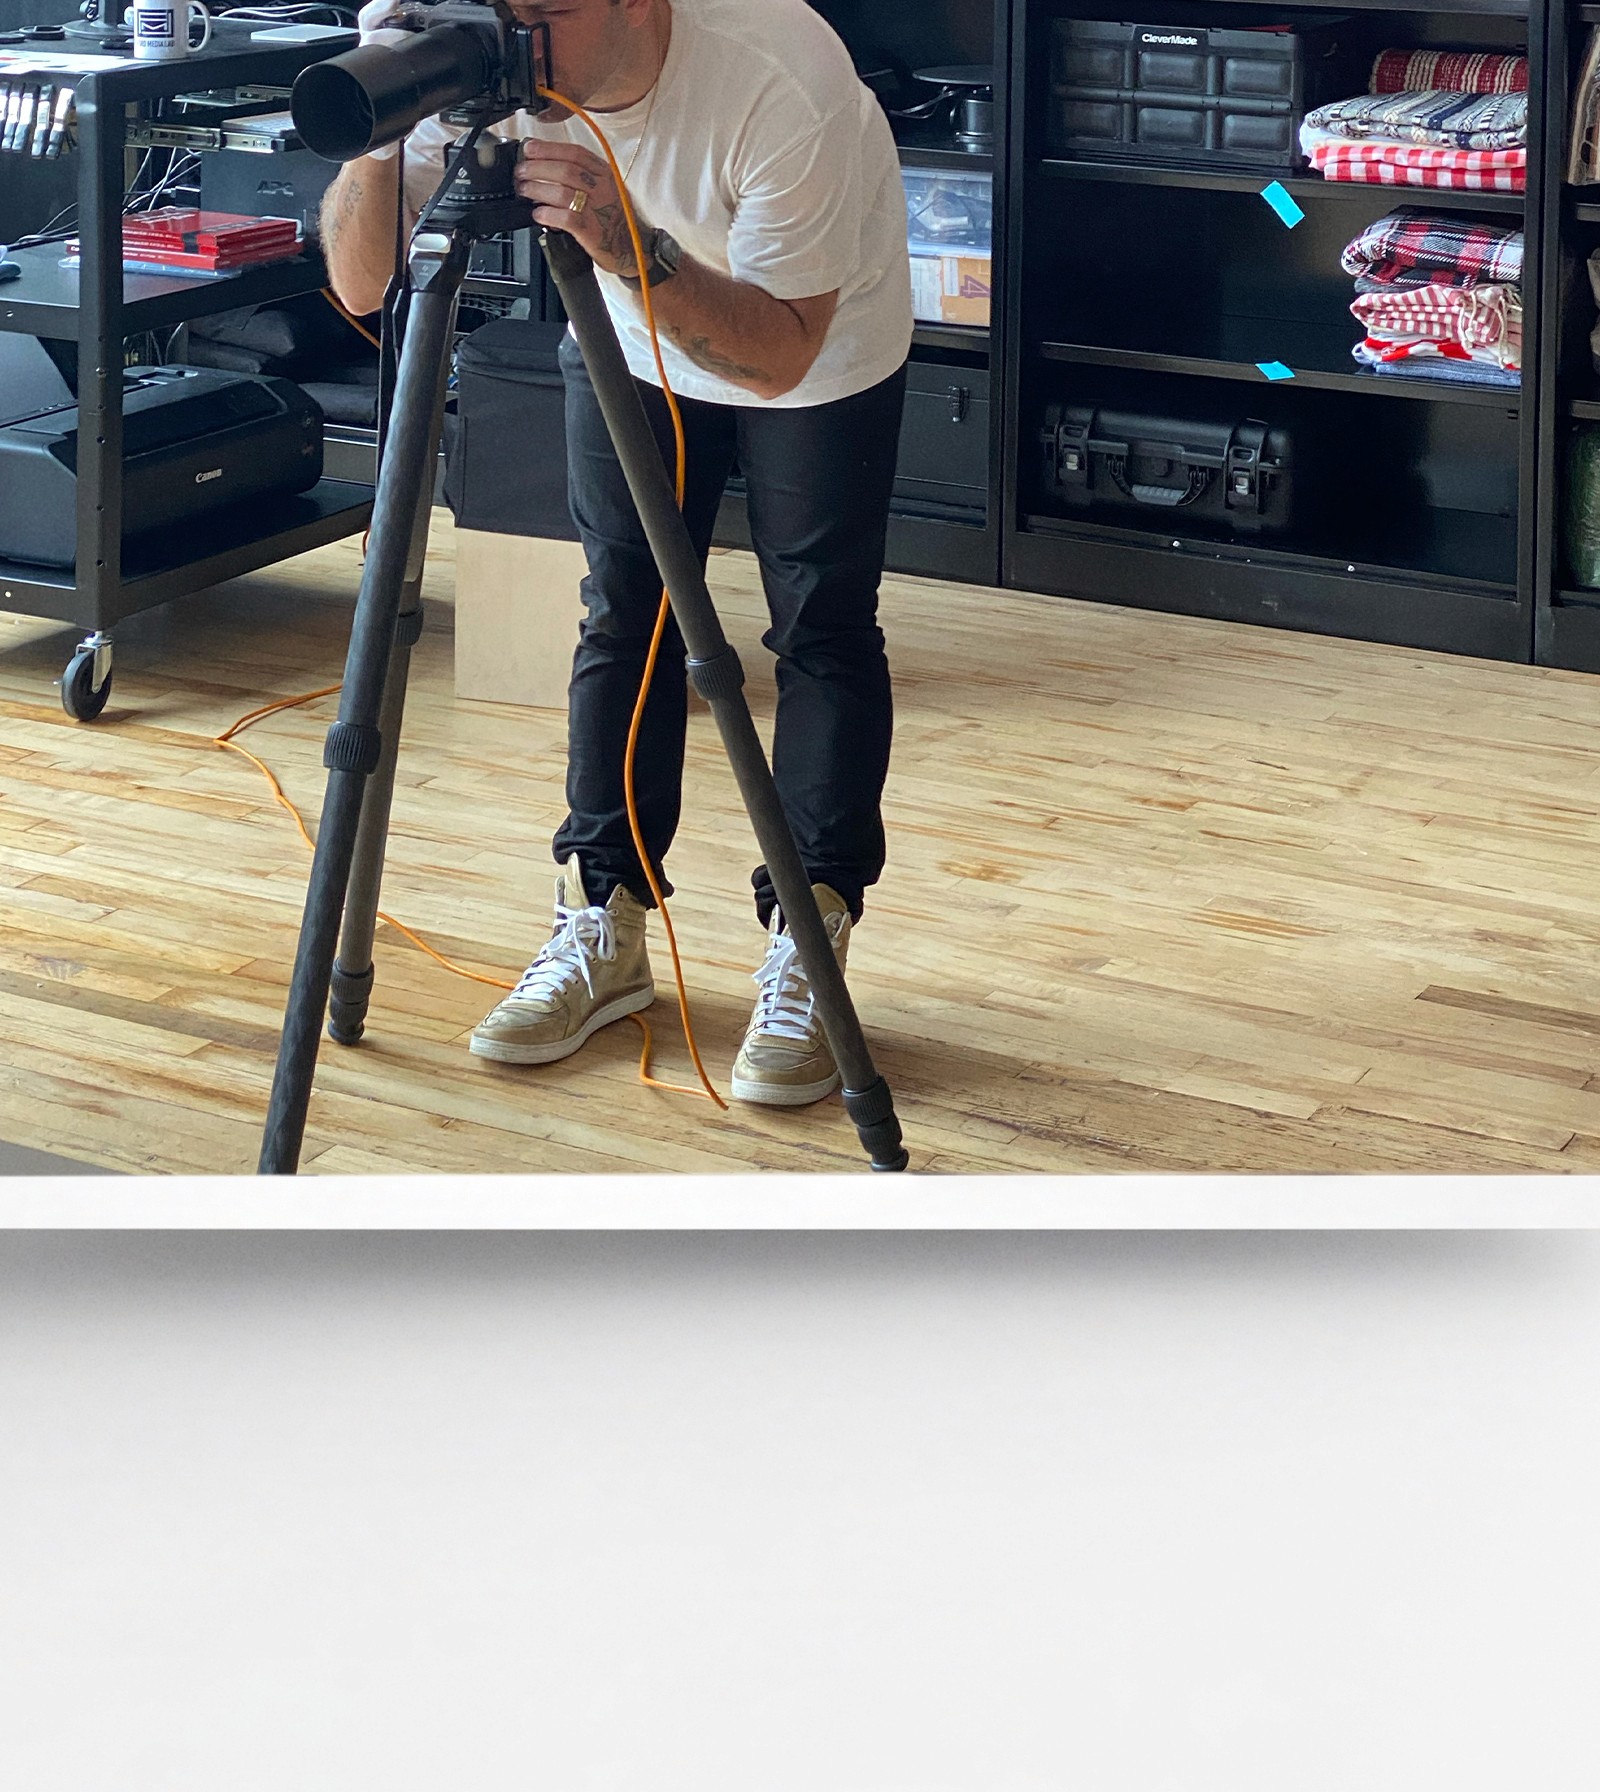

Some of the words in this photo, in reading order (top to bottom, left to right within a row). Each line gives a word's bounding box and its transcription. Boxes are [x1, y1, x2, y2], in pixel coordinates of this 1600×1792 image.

[1141, 33, 1198, 46] CleverMade
[256, 180, 294, 197] APC
[195, 468, 222, 484] Canon
